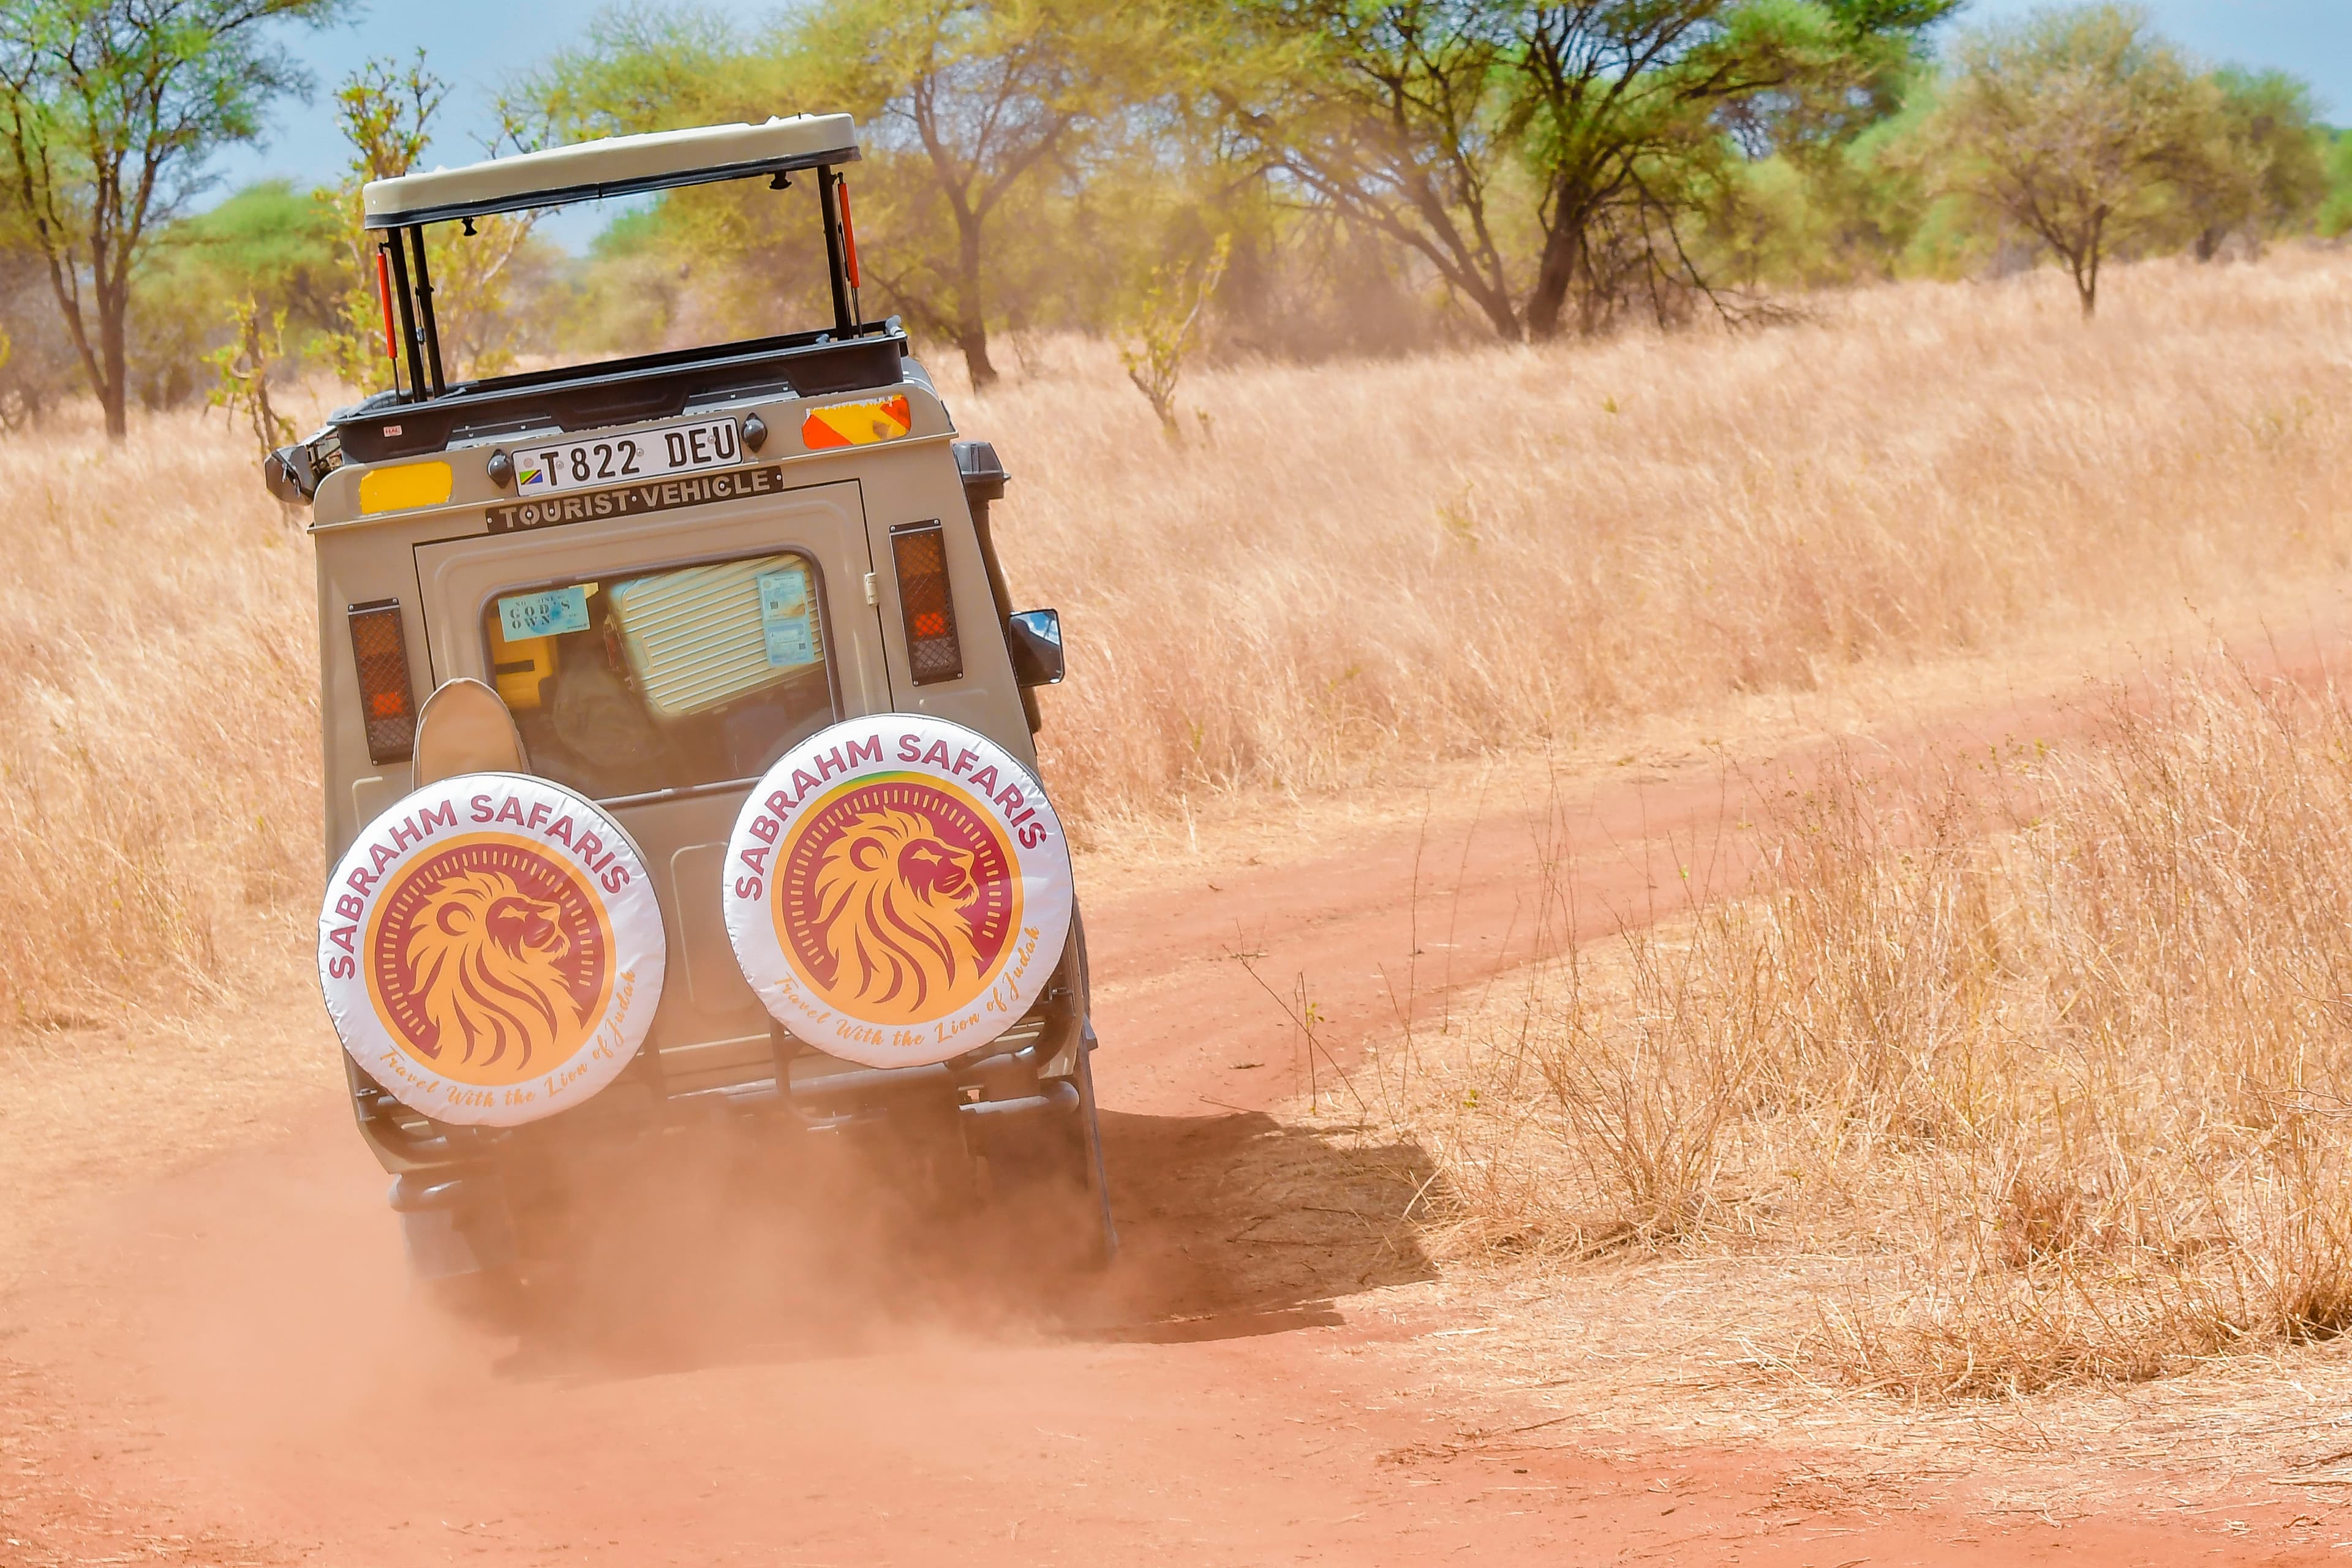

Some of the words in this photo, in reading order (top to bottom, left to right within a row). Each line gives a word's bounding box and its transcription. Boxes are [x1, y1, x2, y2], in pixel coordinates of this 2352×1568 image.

[499, 490, 630, 529] TOURIST
[640, 470, 770, 507] VEHICLE
[665, 424, 736, 468] DEU
[736, 734, 883, 901] SABRAHM
[897, 734, 1047, 850] SAFARIS
[330, 800, 458, 979] SABRAHM
[470, 794, 630, 894] SAFARIS
[380, 1045, 439, 1093] Travel
[447, 1086, 495, 1107] With
[504, 1088, 535, 1105] the
[545, 1063, 587, 1097] Lion
[593, 1035, 613, 1059] of
[605, 970, 635, 1047] Judah
[774, 970, 831, 1023] Travel
[837, 1019, 884, 1045] With
[892, 1030, 924, 1046] the
[935, 1013, 979, 1043] Lion
[987, 987, 1007, 1012] of
[1003, 926, 1039, 1001] Judah
